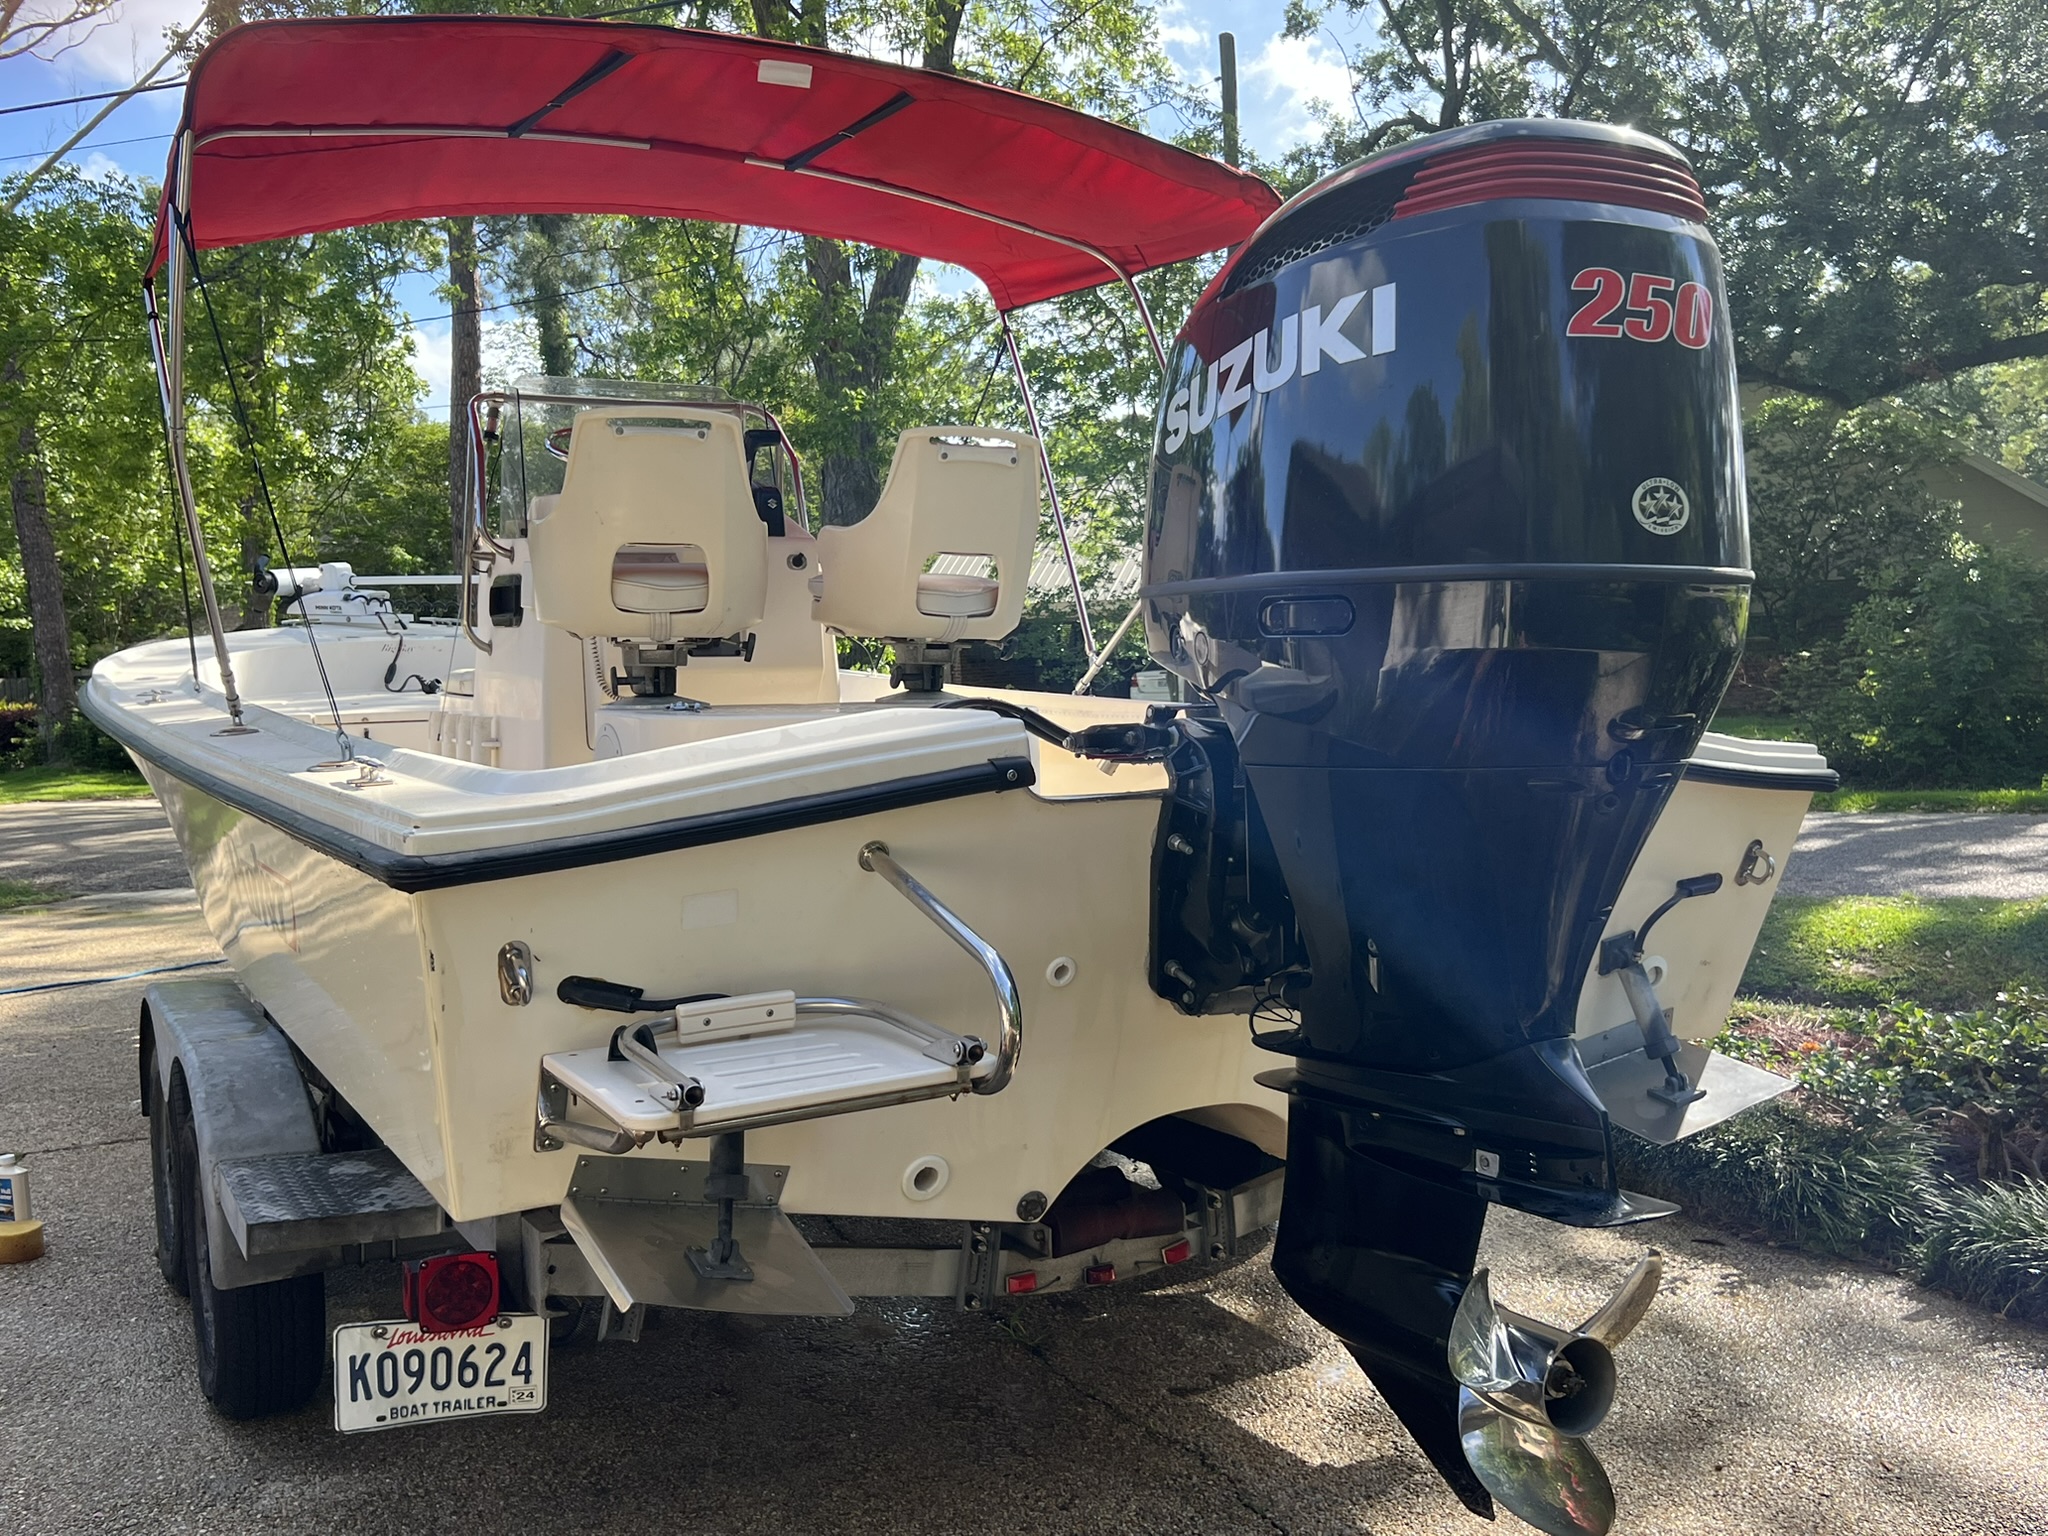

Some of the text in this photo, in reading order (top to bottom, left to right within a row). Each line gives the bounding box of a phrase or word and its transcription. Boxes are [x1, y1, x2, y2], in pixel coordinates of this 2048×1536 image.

[1566, 267, 1713, 350] 250
[1164, 281, 1397, 455] SUZUKI
[348, 1341, 533, 1403] K090624
[516, 1391, 535, 1400] 24
[390, 1402, 429, 1420] BOAT
[432, 1395, 496, 1414] TRAILER
